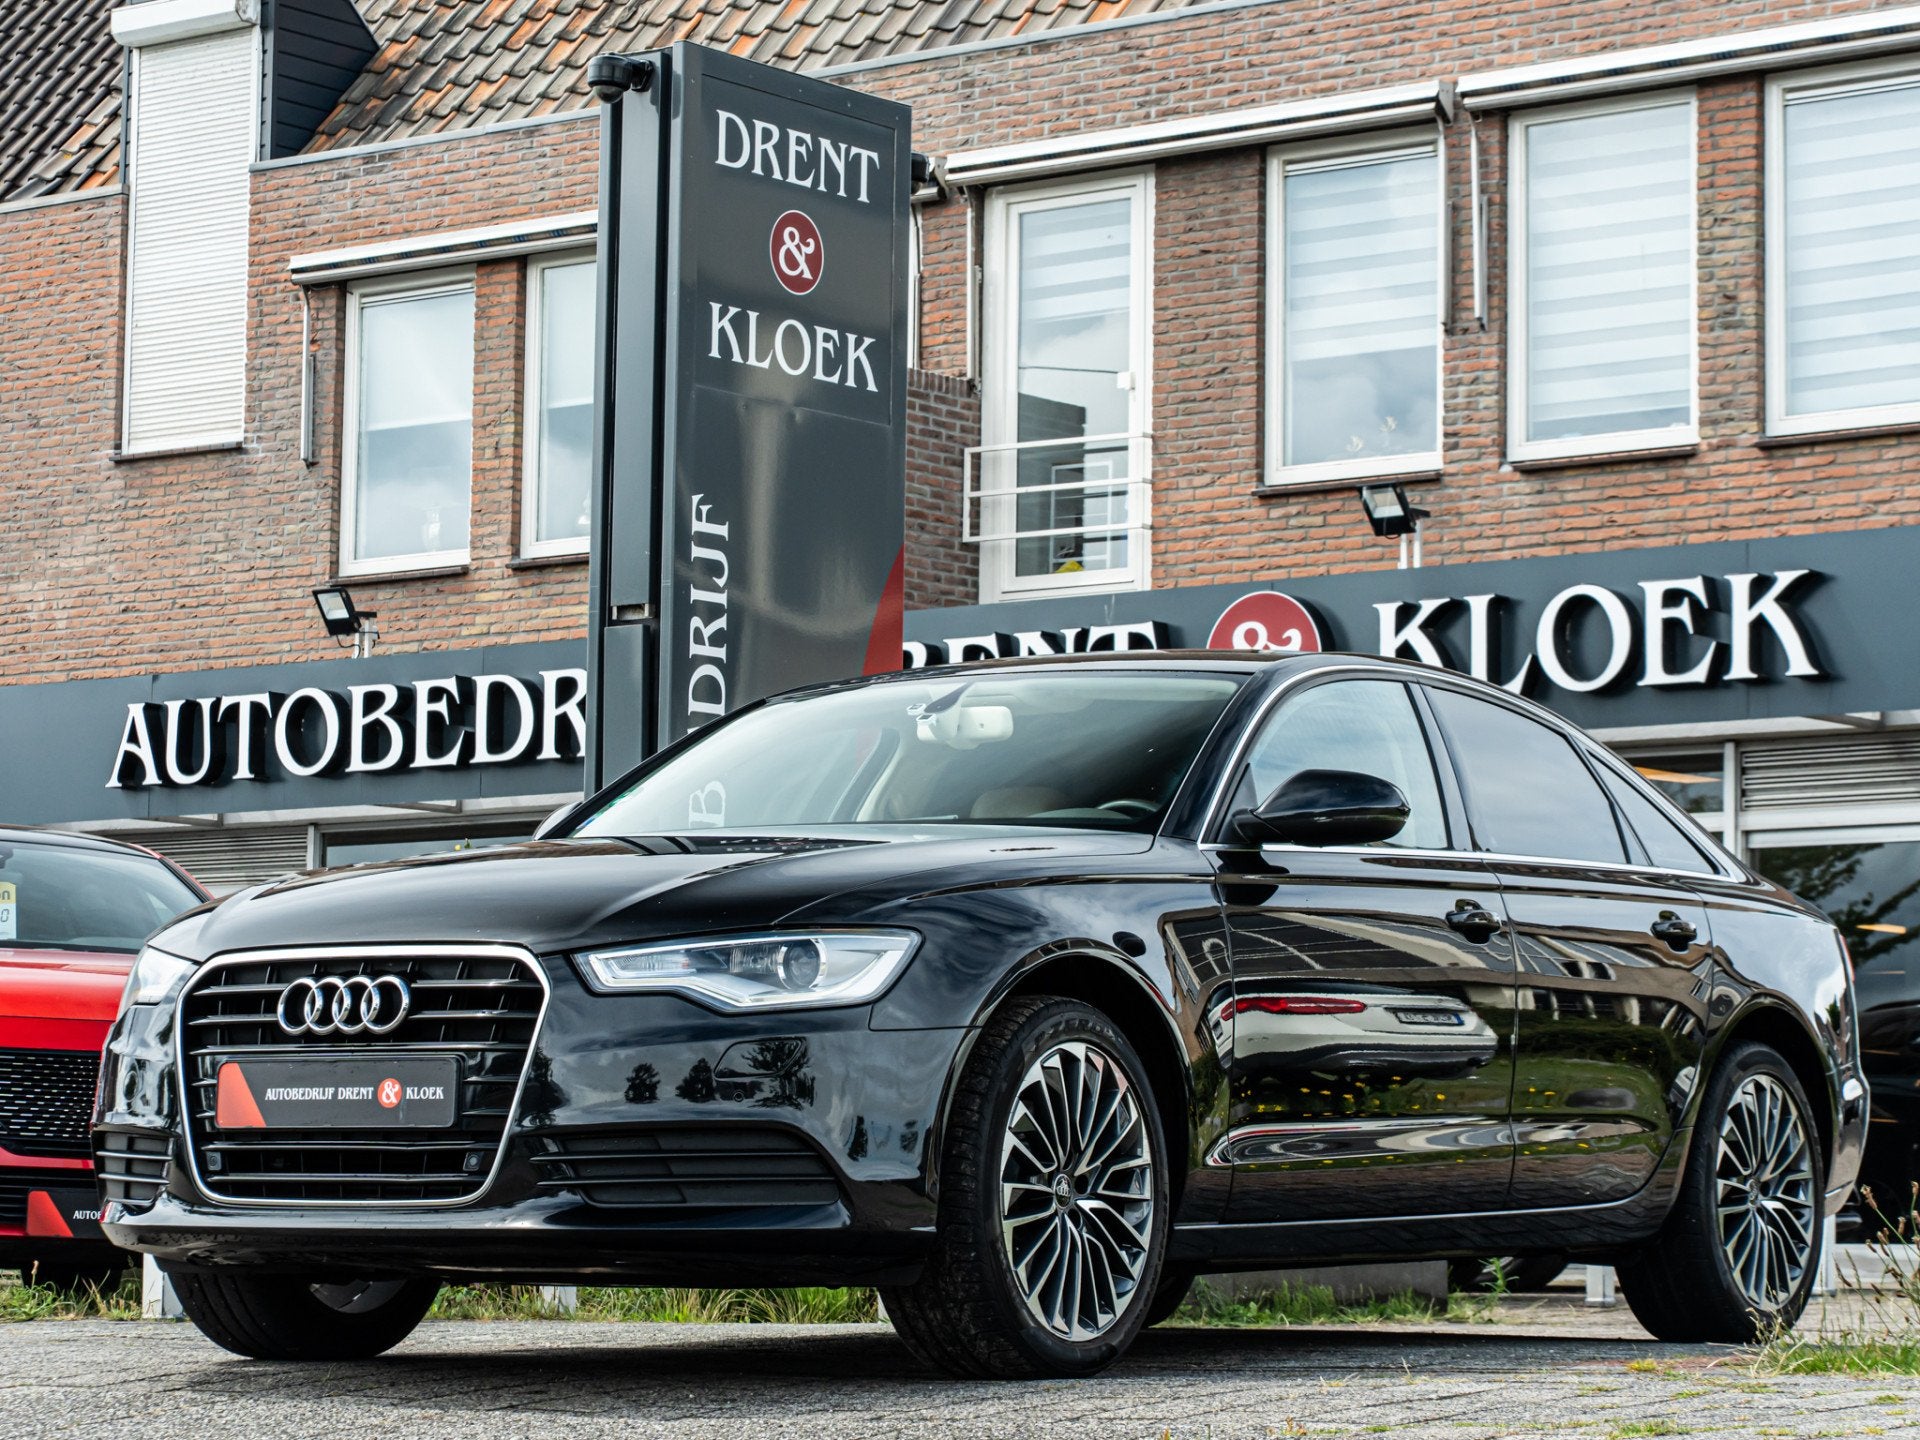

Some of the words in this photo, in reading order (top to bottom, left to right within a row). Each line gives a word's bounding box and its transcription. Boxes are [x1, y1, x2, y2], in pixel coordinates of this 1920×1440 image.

[715, 109, 880, 203] DRENT
[779, 226, 815, 280] &
[708, 302, 879, 392] KLOEK
[1373, 569, 1819, 694] KLOEK
[264, 1087, 335, 1101] AUTOBEDRIJF
[337, 1086, 374, 1100] DRENT
[381, 1081, 400, 1104] &
[405, 1086, 444, 1100] KLOEK
